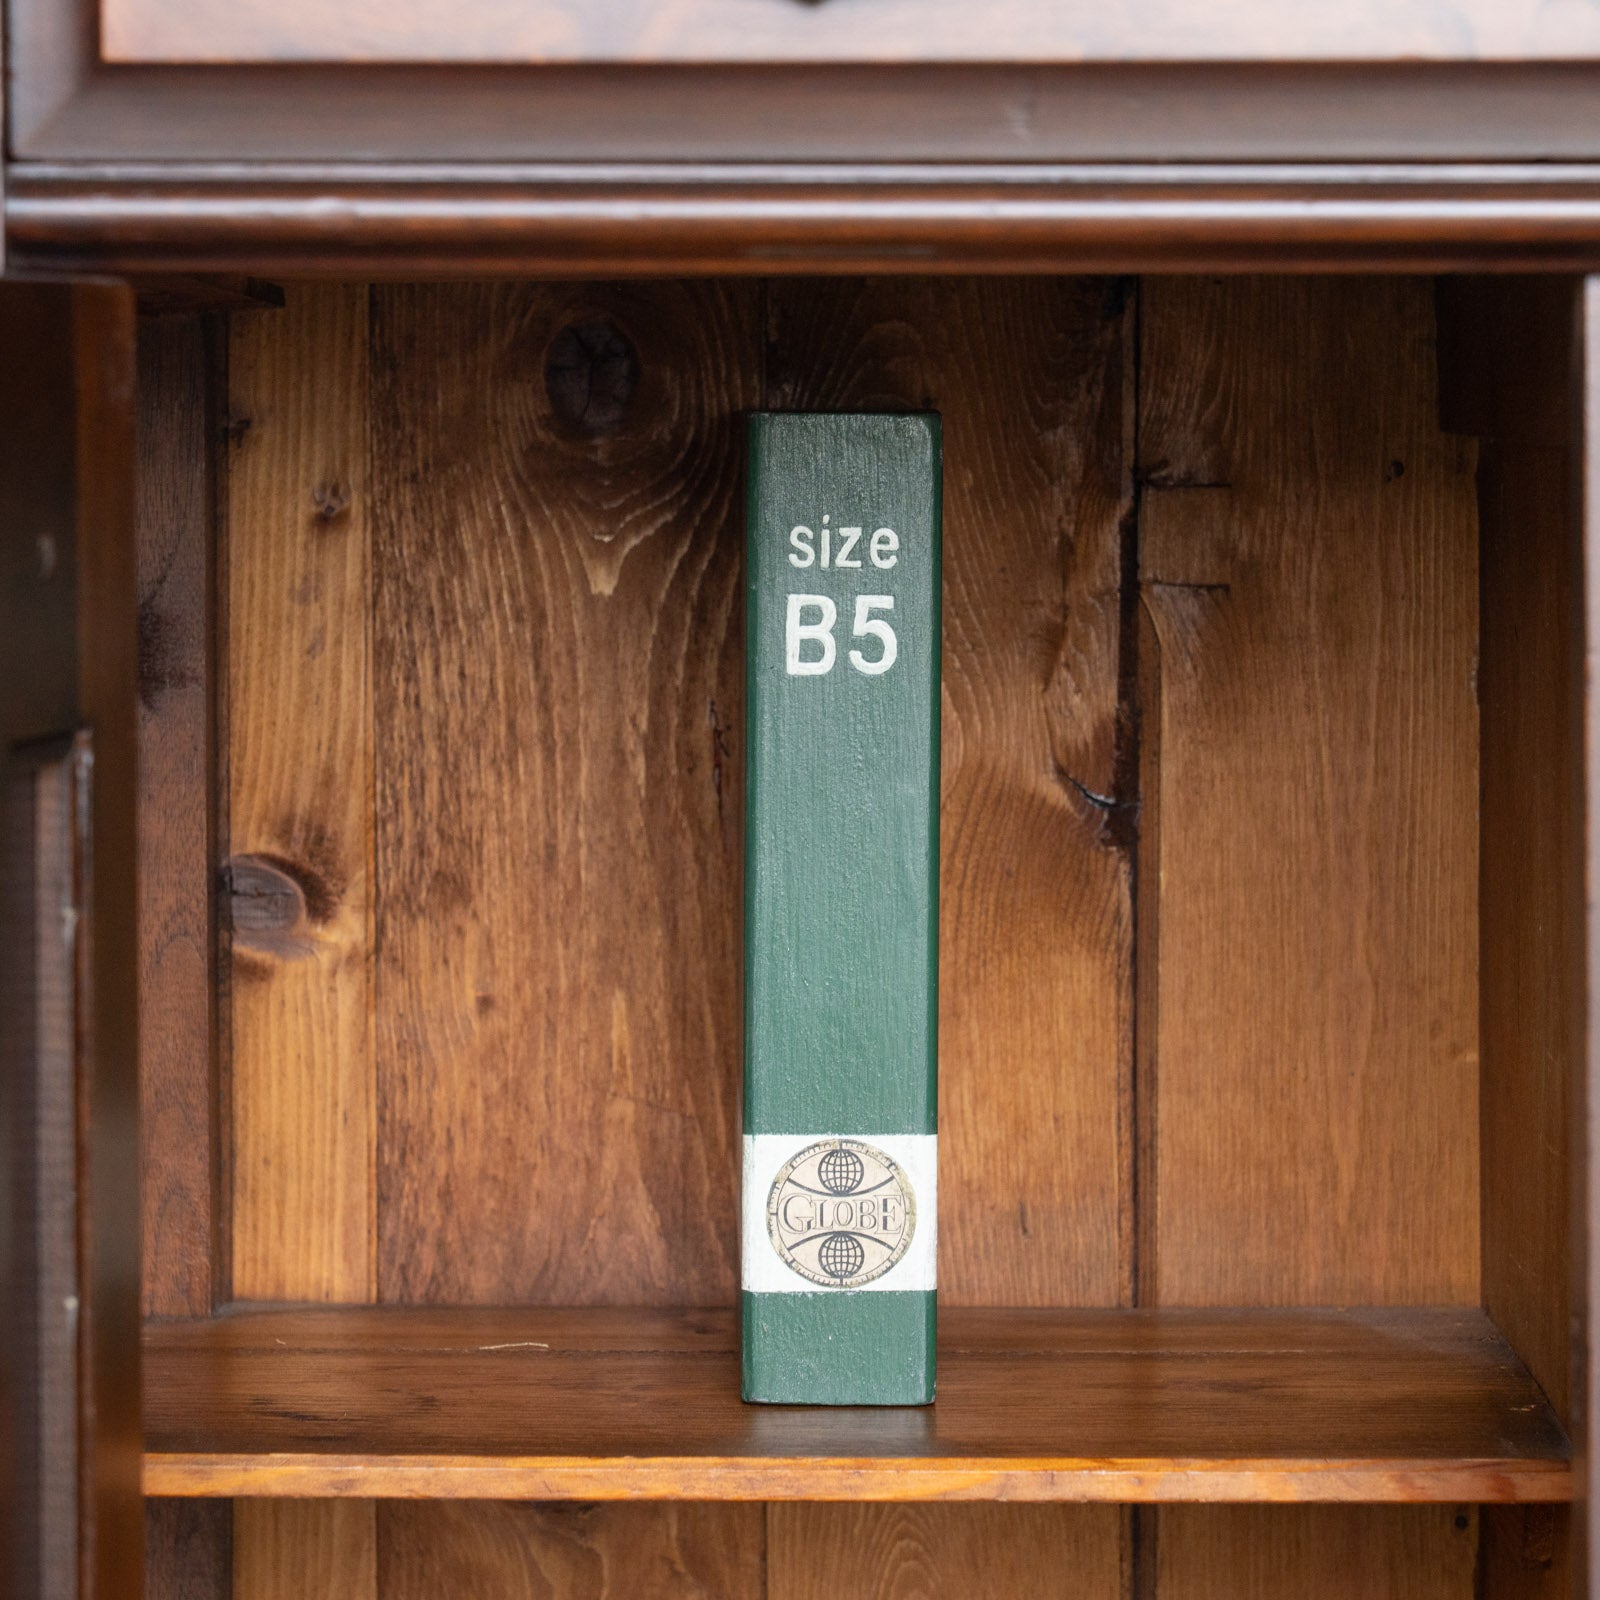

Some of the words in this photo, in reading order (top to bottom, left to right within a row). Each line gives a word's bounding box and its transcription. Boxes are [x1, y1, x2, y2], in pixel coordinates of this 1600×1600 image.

[787, 514, 899, 570] size
[785, 593, 898, 676] B5
[778, 1193, 903, 1235] GLOBE
